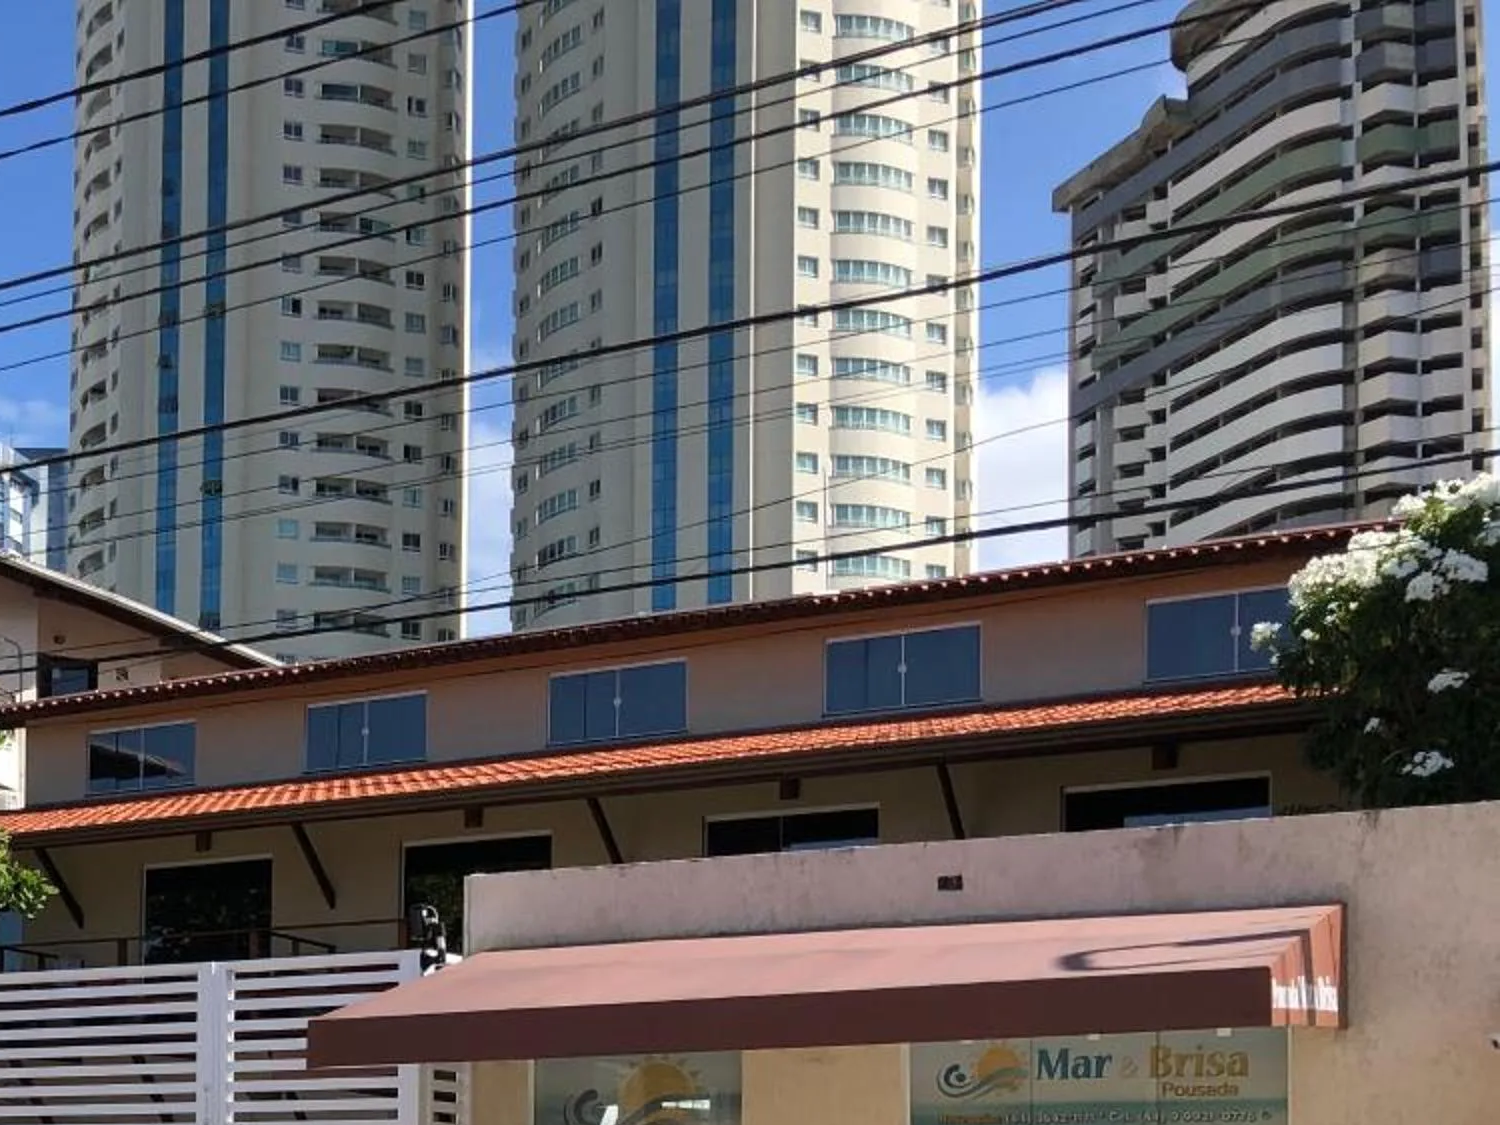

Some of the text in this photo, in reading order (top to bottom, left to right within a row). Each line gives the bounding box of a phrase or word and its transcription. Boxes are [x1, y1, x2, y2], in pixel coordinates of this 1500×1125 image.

[1036, 1047, 1112, 1081] Mar
[1149, 1045, 1248, 1078] Brisa
[1162, 1081, 1239, 1097] Pousada
